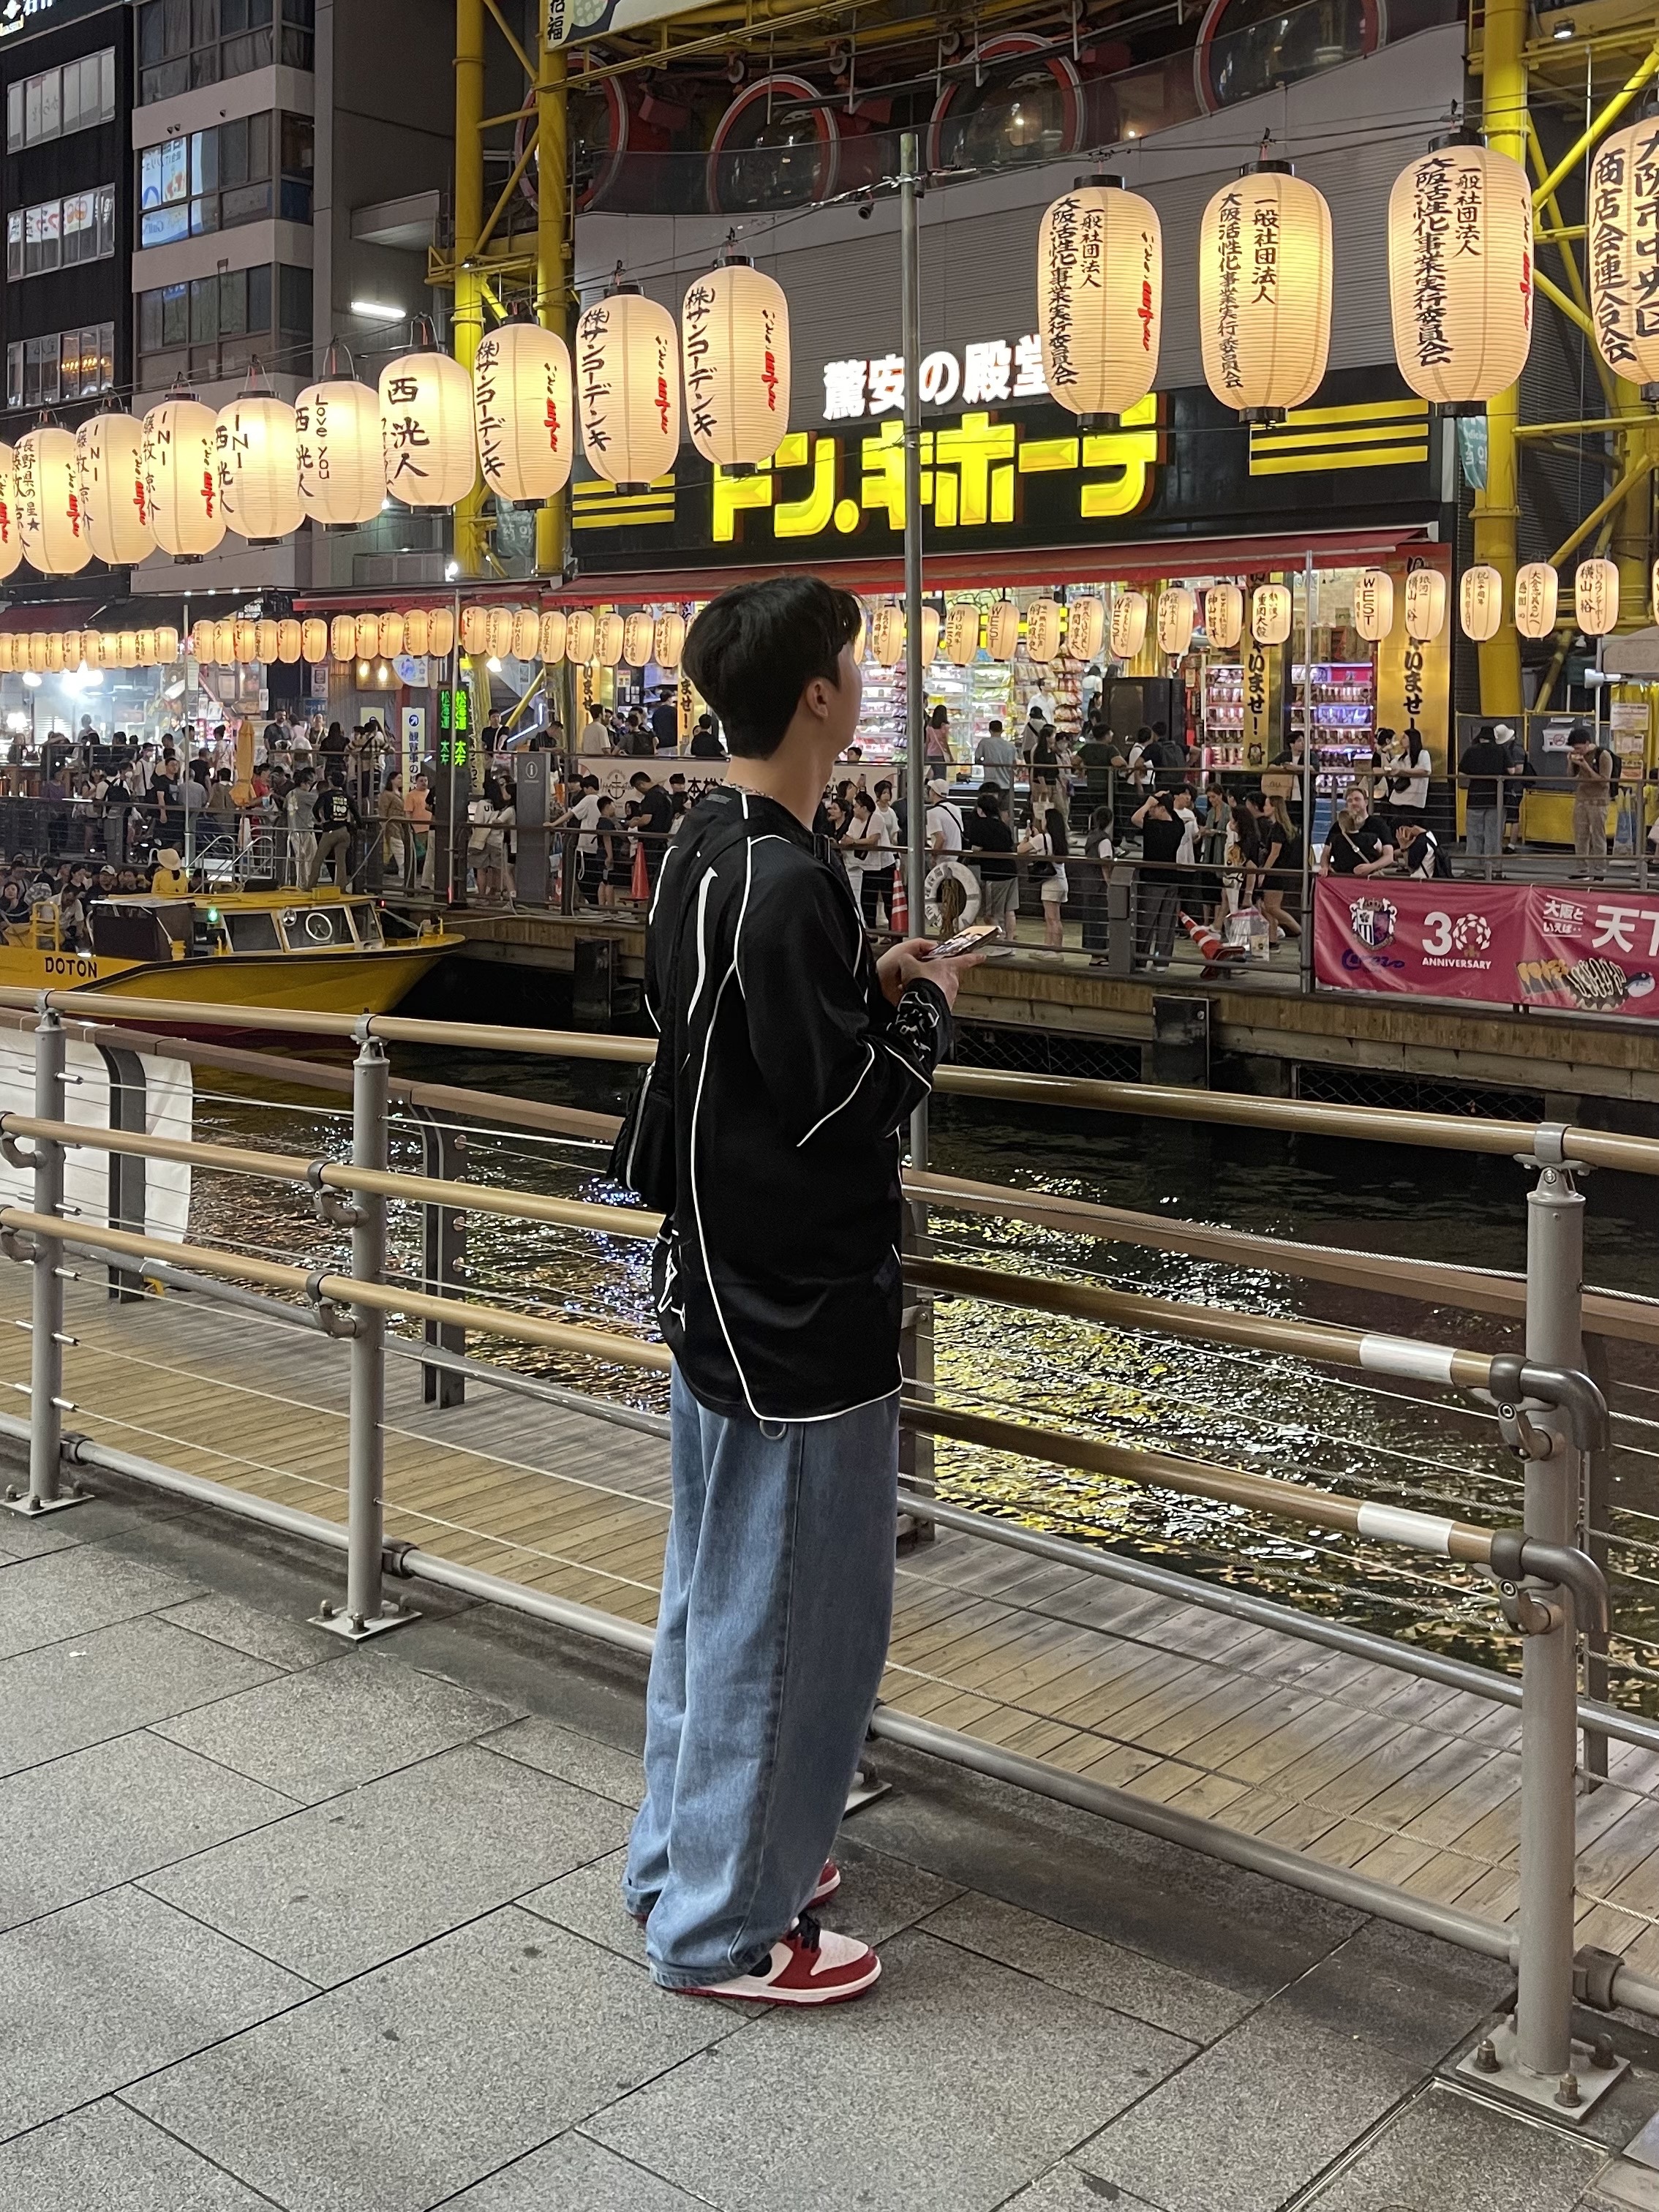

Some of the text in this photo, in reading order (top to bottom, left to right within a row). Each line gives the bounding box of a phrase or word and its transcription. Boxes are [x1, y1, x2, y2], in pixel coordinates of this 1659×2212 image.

[1453, 167, 1483, 259] 一般社団法人
[1080, 208, 1105, 290] 一般社団法人
[1252, 198, 1279, 304] 一般社団法人
[1412, 157, 1457, 367] 大阪活性化事業実行委員会
[1593, 148, 1638, 364] 商店会連合会
[1047, 197, 1082, 386] 大阪活性化事業実行委員会
[1218, 192, 1244, 388] 大阪活性化事業実行委員会
[823, 332, 1051, 421] 驚安の殿堂
[90, 424, 100, 482] INI
[157, 410, 170, 466] INI
[232, 414, 249, 469] INI
[315, 393, 330, 480] Love you
[989, 606, 1003, 648] WEST
[1112, 597, 1125, 645] WEST
[1362, 577, 1376, 626] WEST
[1543, 900, 1584, 921] 大阪と
[45, 957, 97, 979] DOTON
[1421, 957, 1492, 970] ANNIVERSARY
